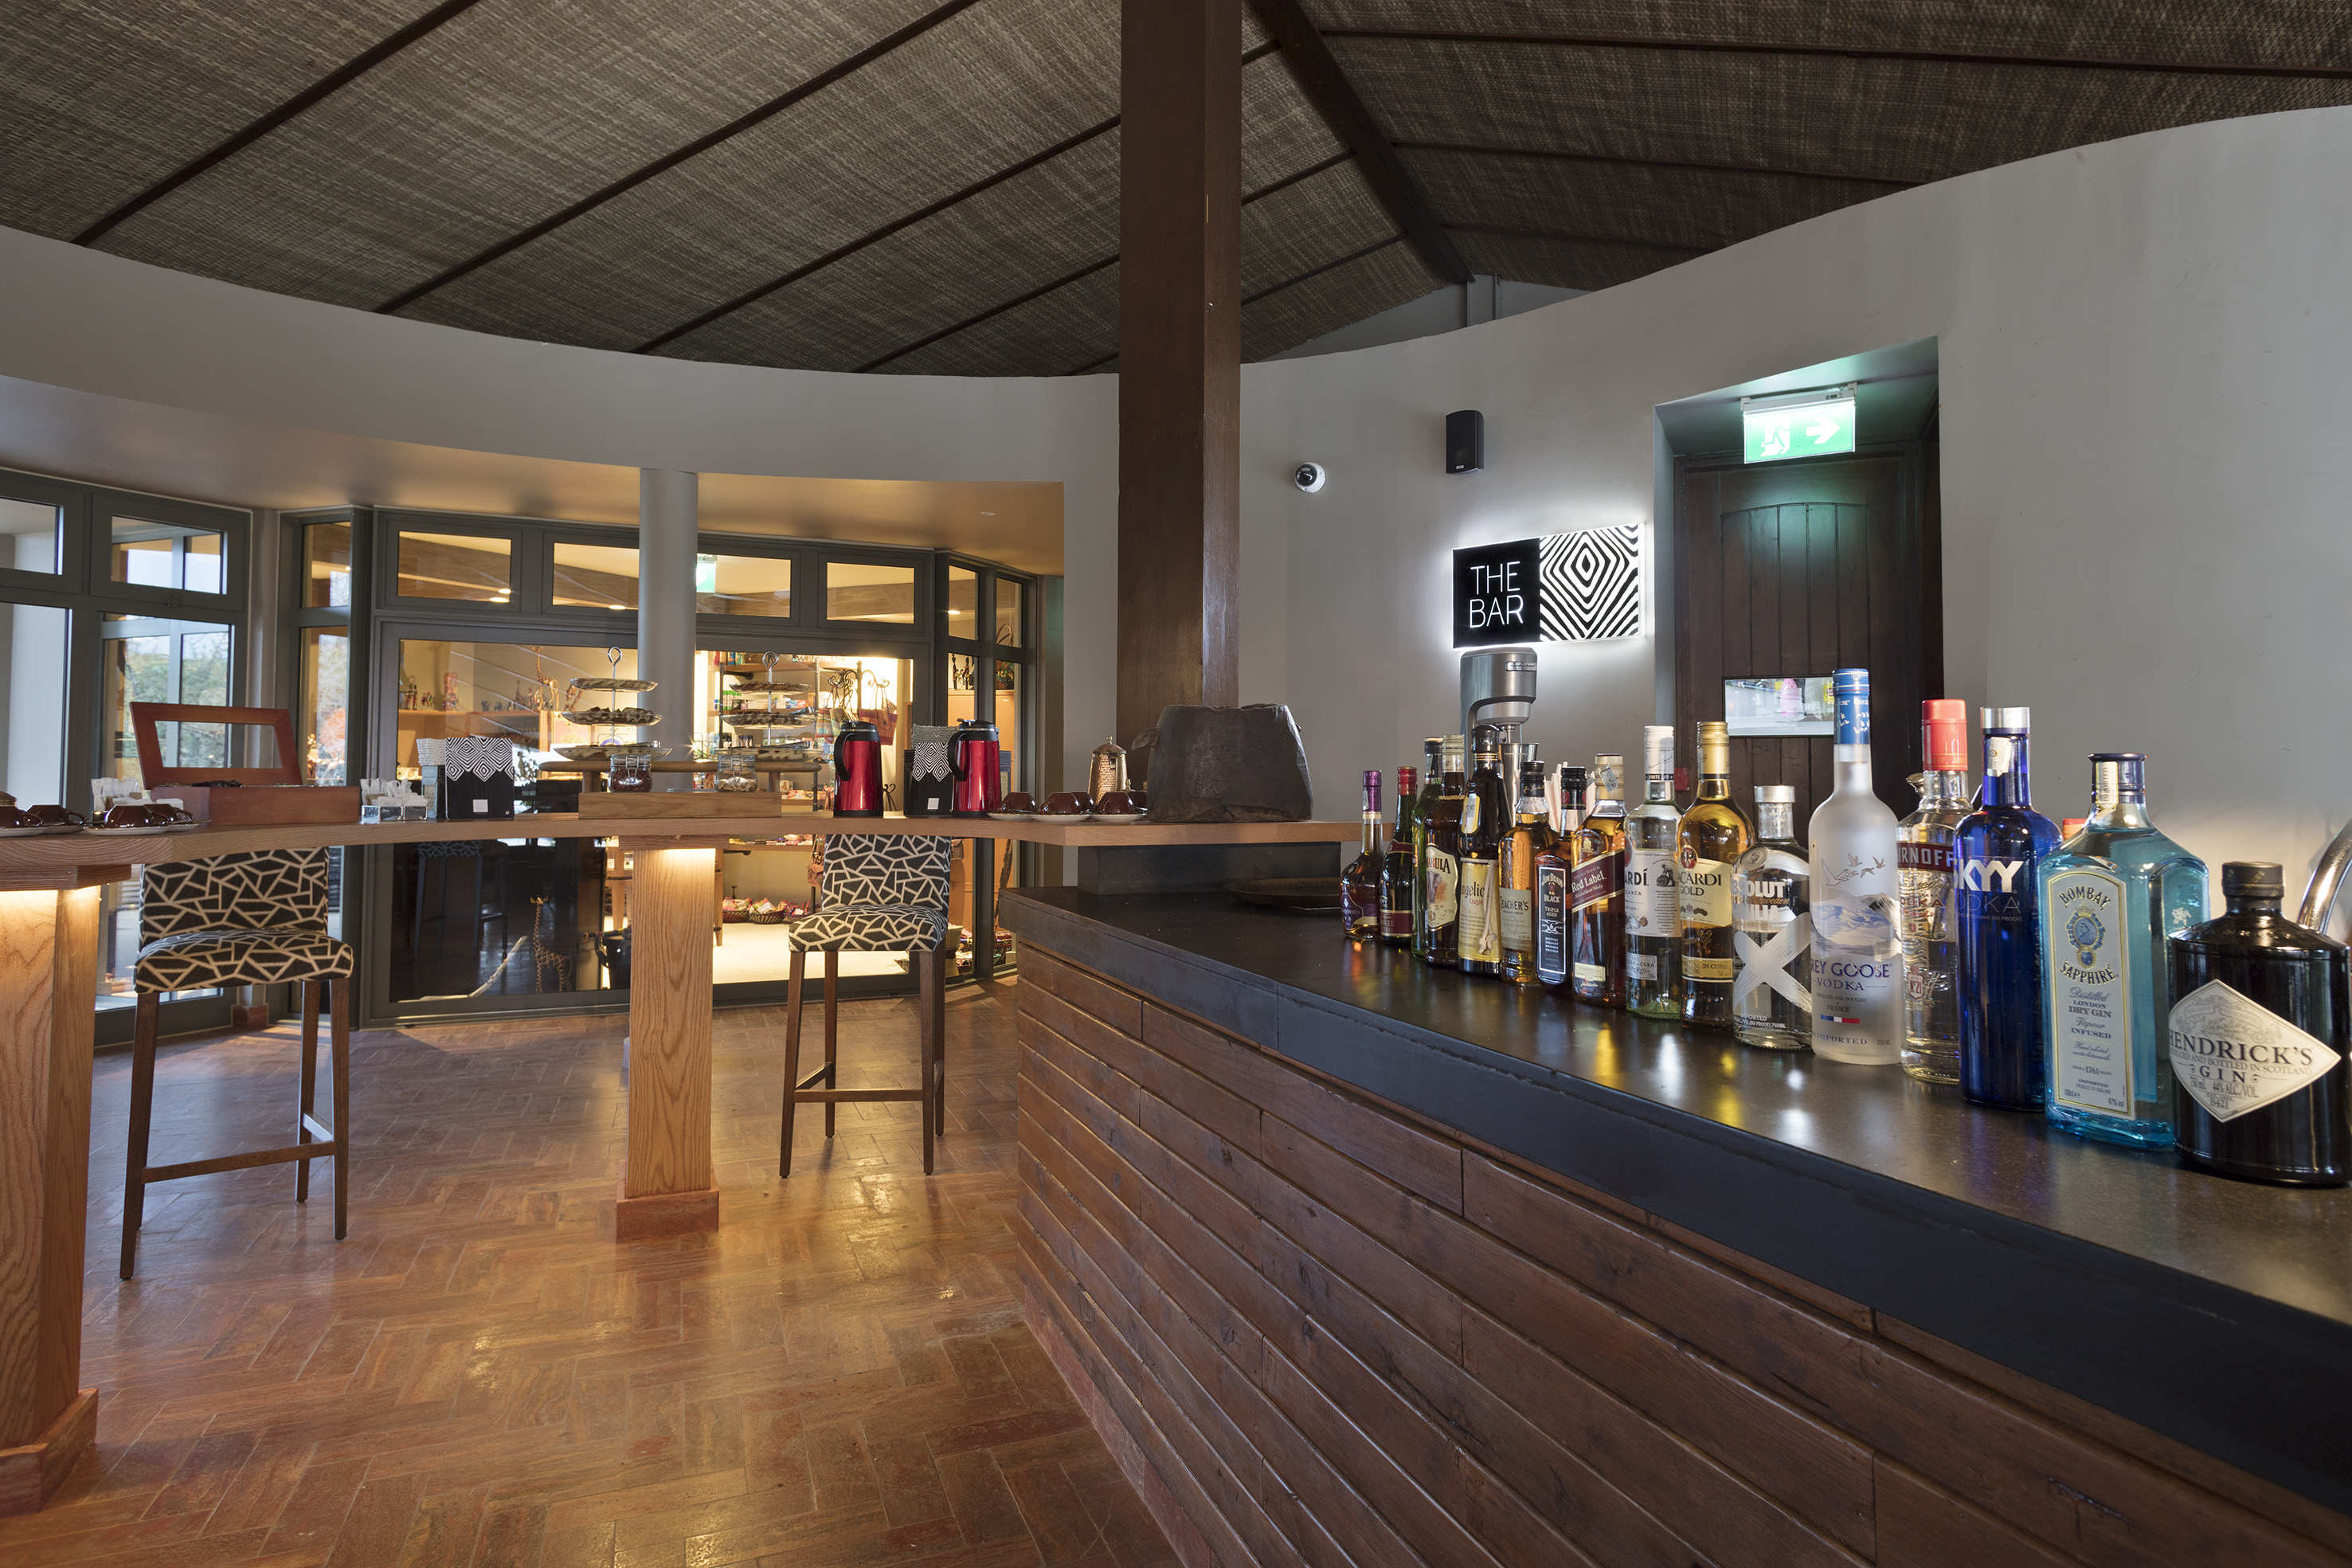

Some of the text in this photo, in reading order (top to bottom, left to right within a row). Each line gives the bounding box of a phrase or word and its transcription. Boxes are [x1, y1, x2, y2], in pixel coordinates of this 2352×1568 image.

[1470, 561, 1520, 595] THE
[1469, 595, 1524, 628] BAR
[1898, 847, 1954, 867] IRNOFF
[1427, 857, 1451, 874] ARULA
[1550, 873, 1563, 888] BEAM
[1571, 870, 1605, 893] Red Label
[1625, 868, 1648, 886] ARDÍ
[1680, 872, 1722, 886] CARDI
[1680, 886, 1704, 896] GOLD
[1731, 880, 1786, 898] BSOLUT
[1544, 894, 1560, 903] BLACK
[1900, 897, 1944, 908] ODKA
[1958, 893, 2021, 913] ODKA
[2059, 886, 2111, 910] BOMBAY
[1811, 959, 1889, 978] REY GOOSE
[2060, 959, 2115, 985] SAPPHIRE
[1817, 977, 1865, 991] VODKA
[2068, 987, 2110, 1002] Distilled
[1827, 1004, 1851, 1013] FRANCE
[2073, 1000, 2106, 1009] LONDON
[2068, 1006, 2111, 1019] DRY GIN
[2076, 1017, 2105, 1029] Vapour
[1817, 1033, 1867, 1045] IMPORTED
[2071, 1027, 2111, 1038] INFUSED
[2169, 1030, 2313, 1066] HENDRICK'S
[2085, 1066, 2100, 1075] 1761
[2191, 1054, 2206, 1064] AND
[2208, 1058, 2248, 1070] BOTTLED
[2250, 1062, 2260, 1072] IN
[2264, 1066, 2312, 1075] SCOTLAND
[2200, 1066, 2246, 1084] GIN
[2078, 1078, 2108, 1088] IMPORTED
[2213, 1081, 2224, 1093] 44%
[2225, 1084, 2259, 1098] ALC./VOL.
[2108, 1097, 2117, 1106] 47%
